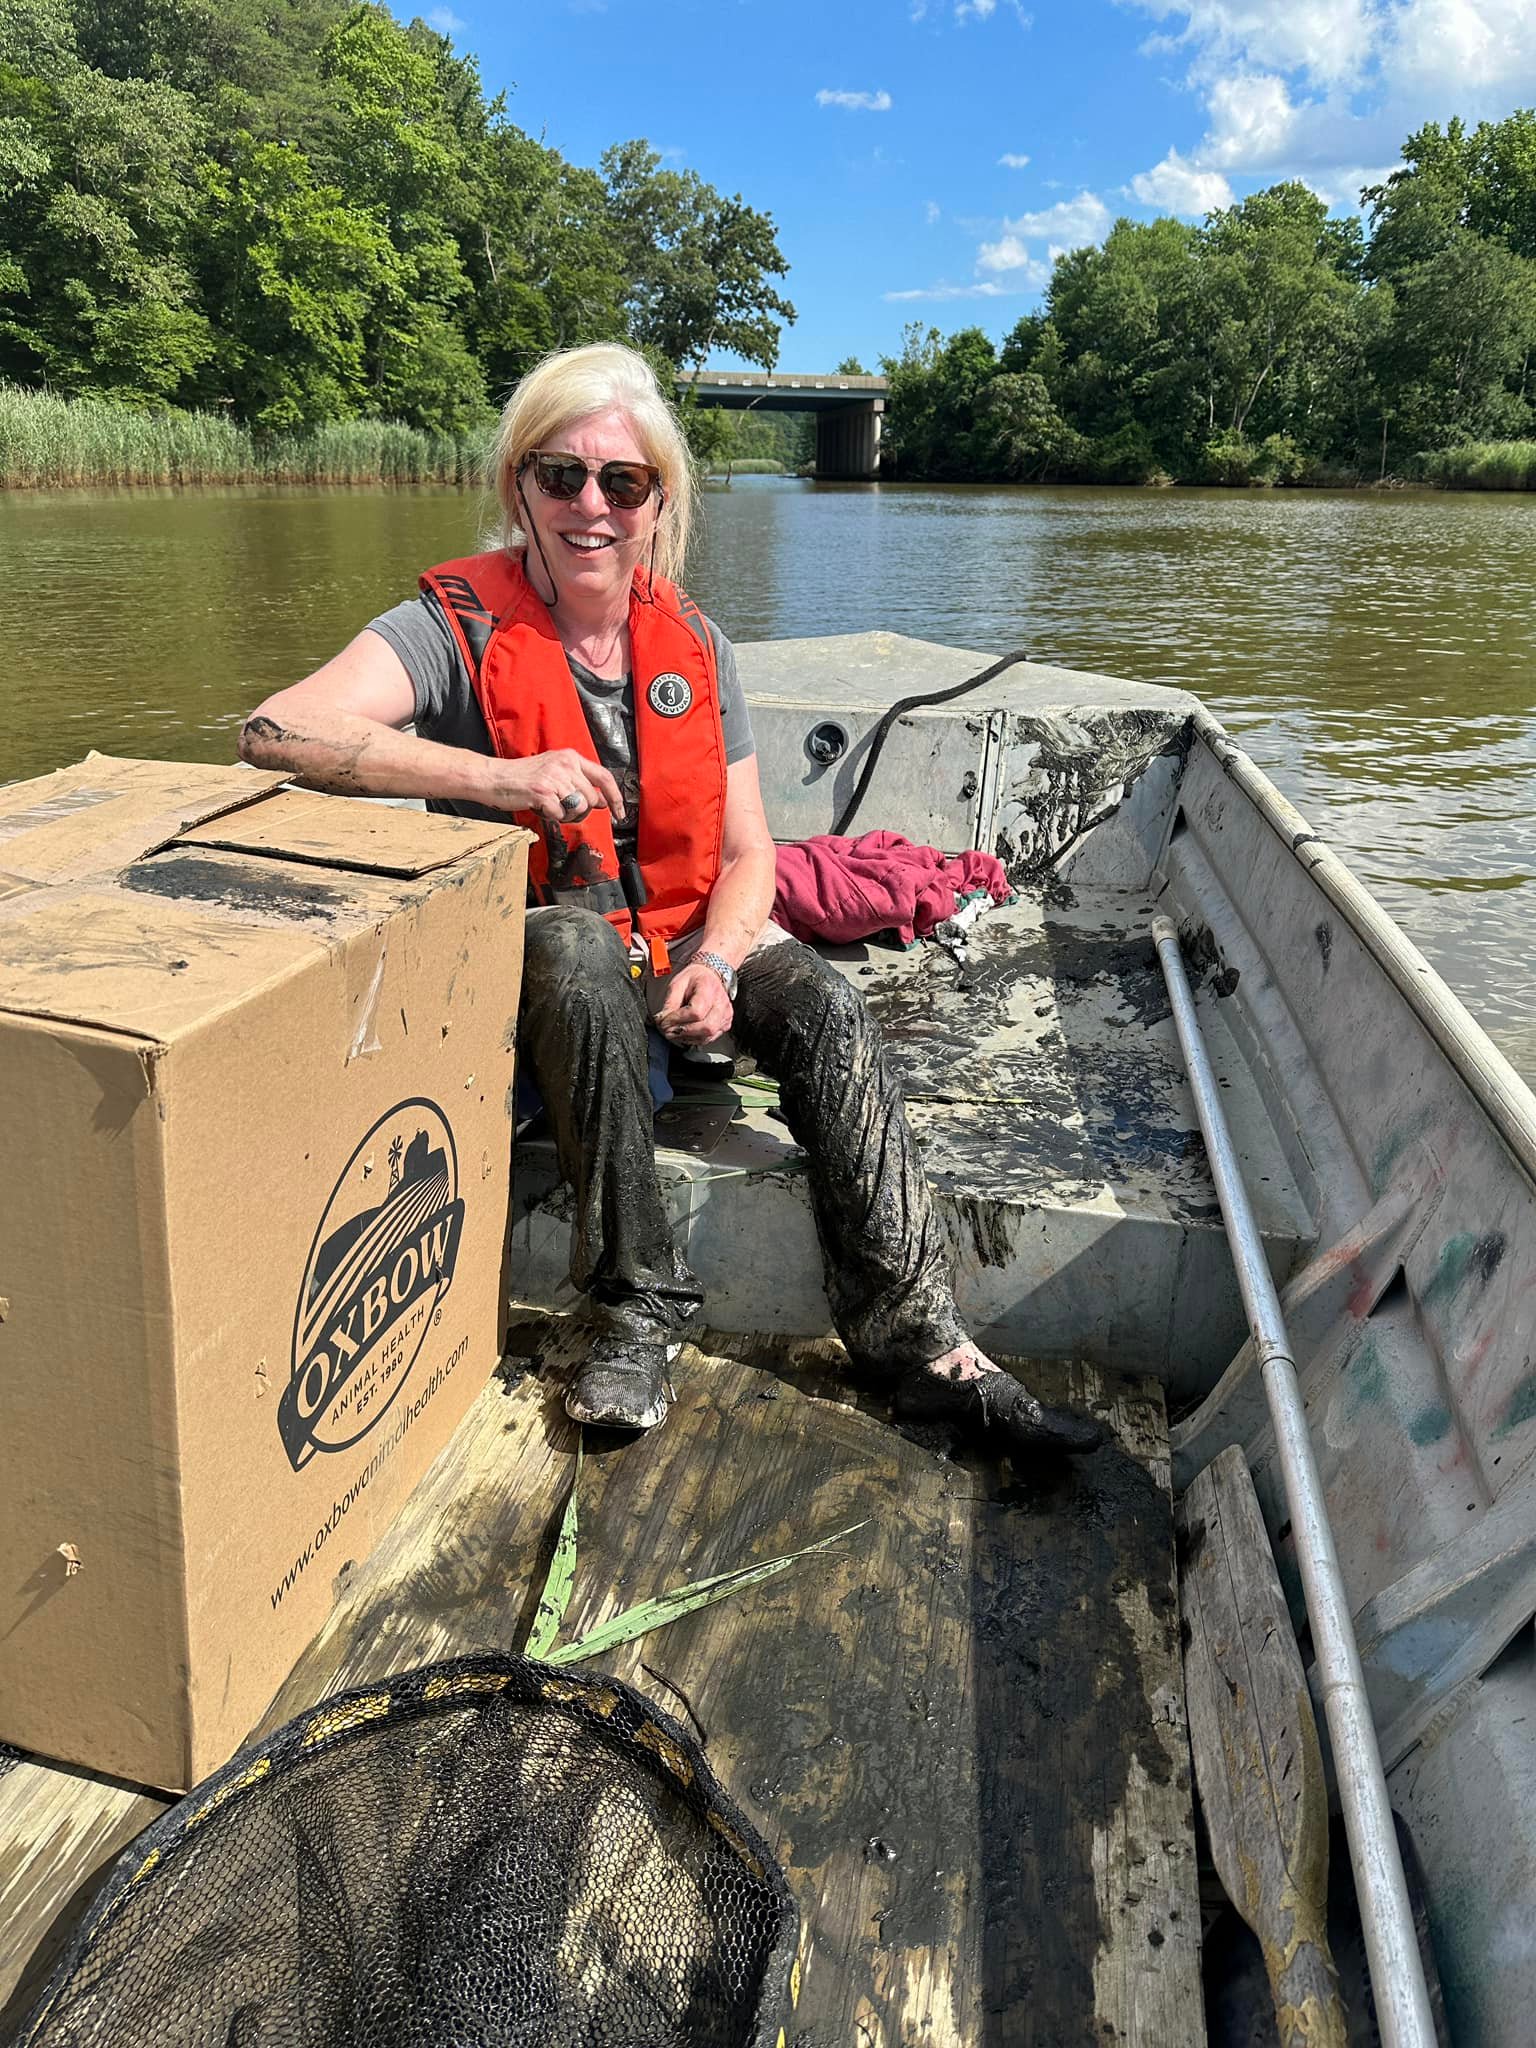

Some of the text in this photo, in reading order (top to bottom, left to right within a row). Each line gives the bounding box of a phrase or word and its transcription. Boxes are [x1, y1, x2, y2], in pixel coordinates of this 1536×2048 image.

[652, 674, 688, 691] MUSTANG
[653, 695, 690, 713] SURVIVAL
[296, 1213, 454, 1419] OXBOW
[331, 1305, 424, 1425] ANIMAL HEALTH
[356, 1351, 403, 1415] EST. 1980
[270, 1335, 469, 1610] www.oxbowanimalhealth.com
